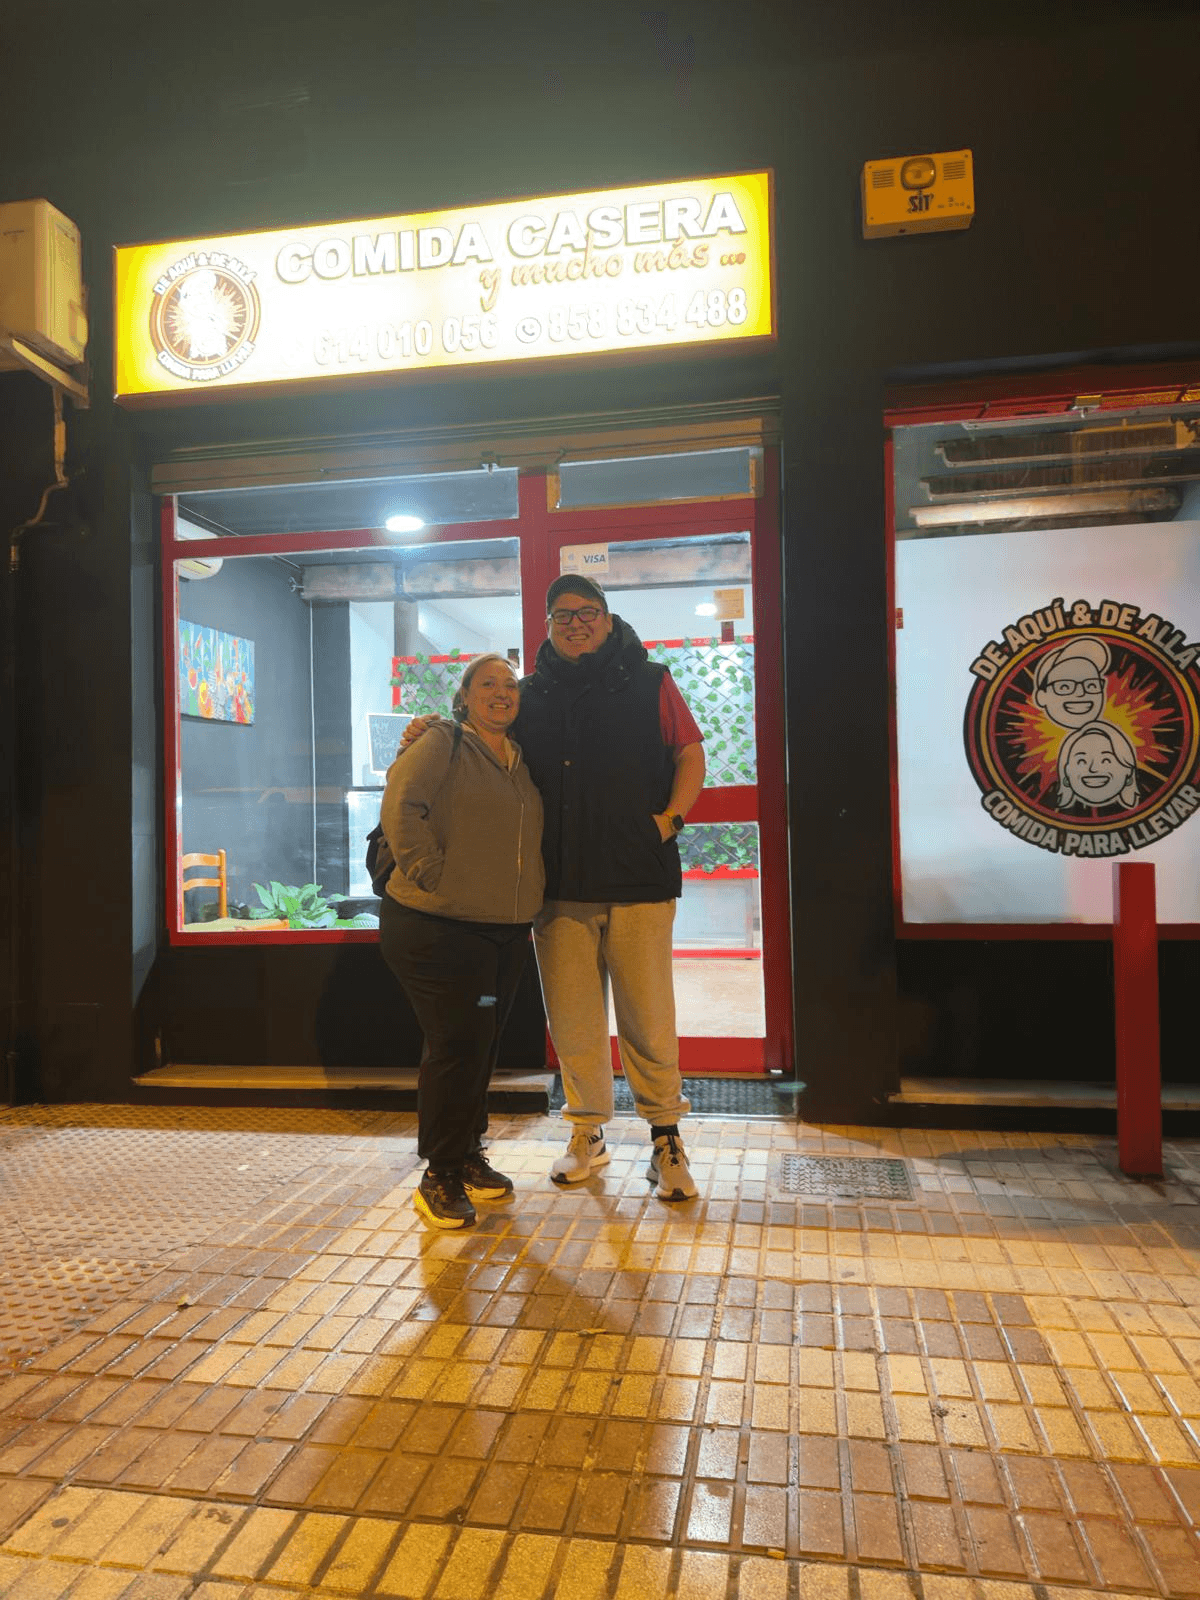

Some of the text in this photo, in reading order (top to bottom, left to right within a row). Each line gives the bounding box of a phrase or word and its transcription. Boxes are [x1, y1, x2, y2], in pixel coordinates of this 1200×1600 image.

[276, 191, 747, 284] COMIDA CASERA
[479, 264, 502, 312] y
[510, 231, 624, 287] mucho
[633, 237, 710, 275] más
[153, 274, 171, 295] DE
[313, 286, 748, 366] 614 010 056 858 834 488
[583, 553, 606, 564] VISA
[970, 597, 1200, 682] DE AQUÍ & DE ALLÁ
[981, 782, 1200, 858] COMIDA PARA LLEVAR
